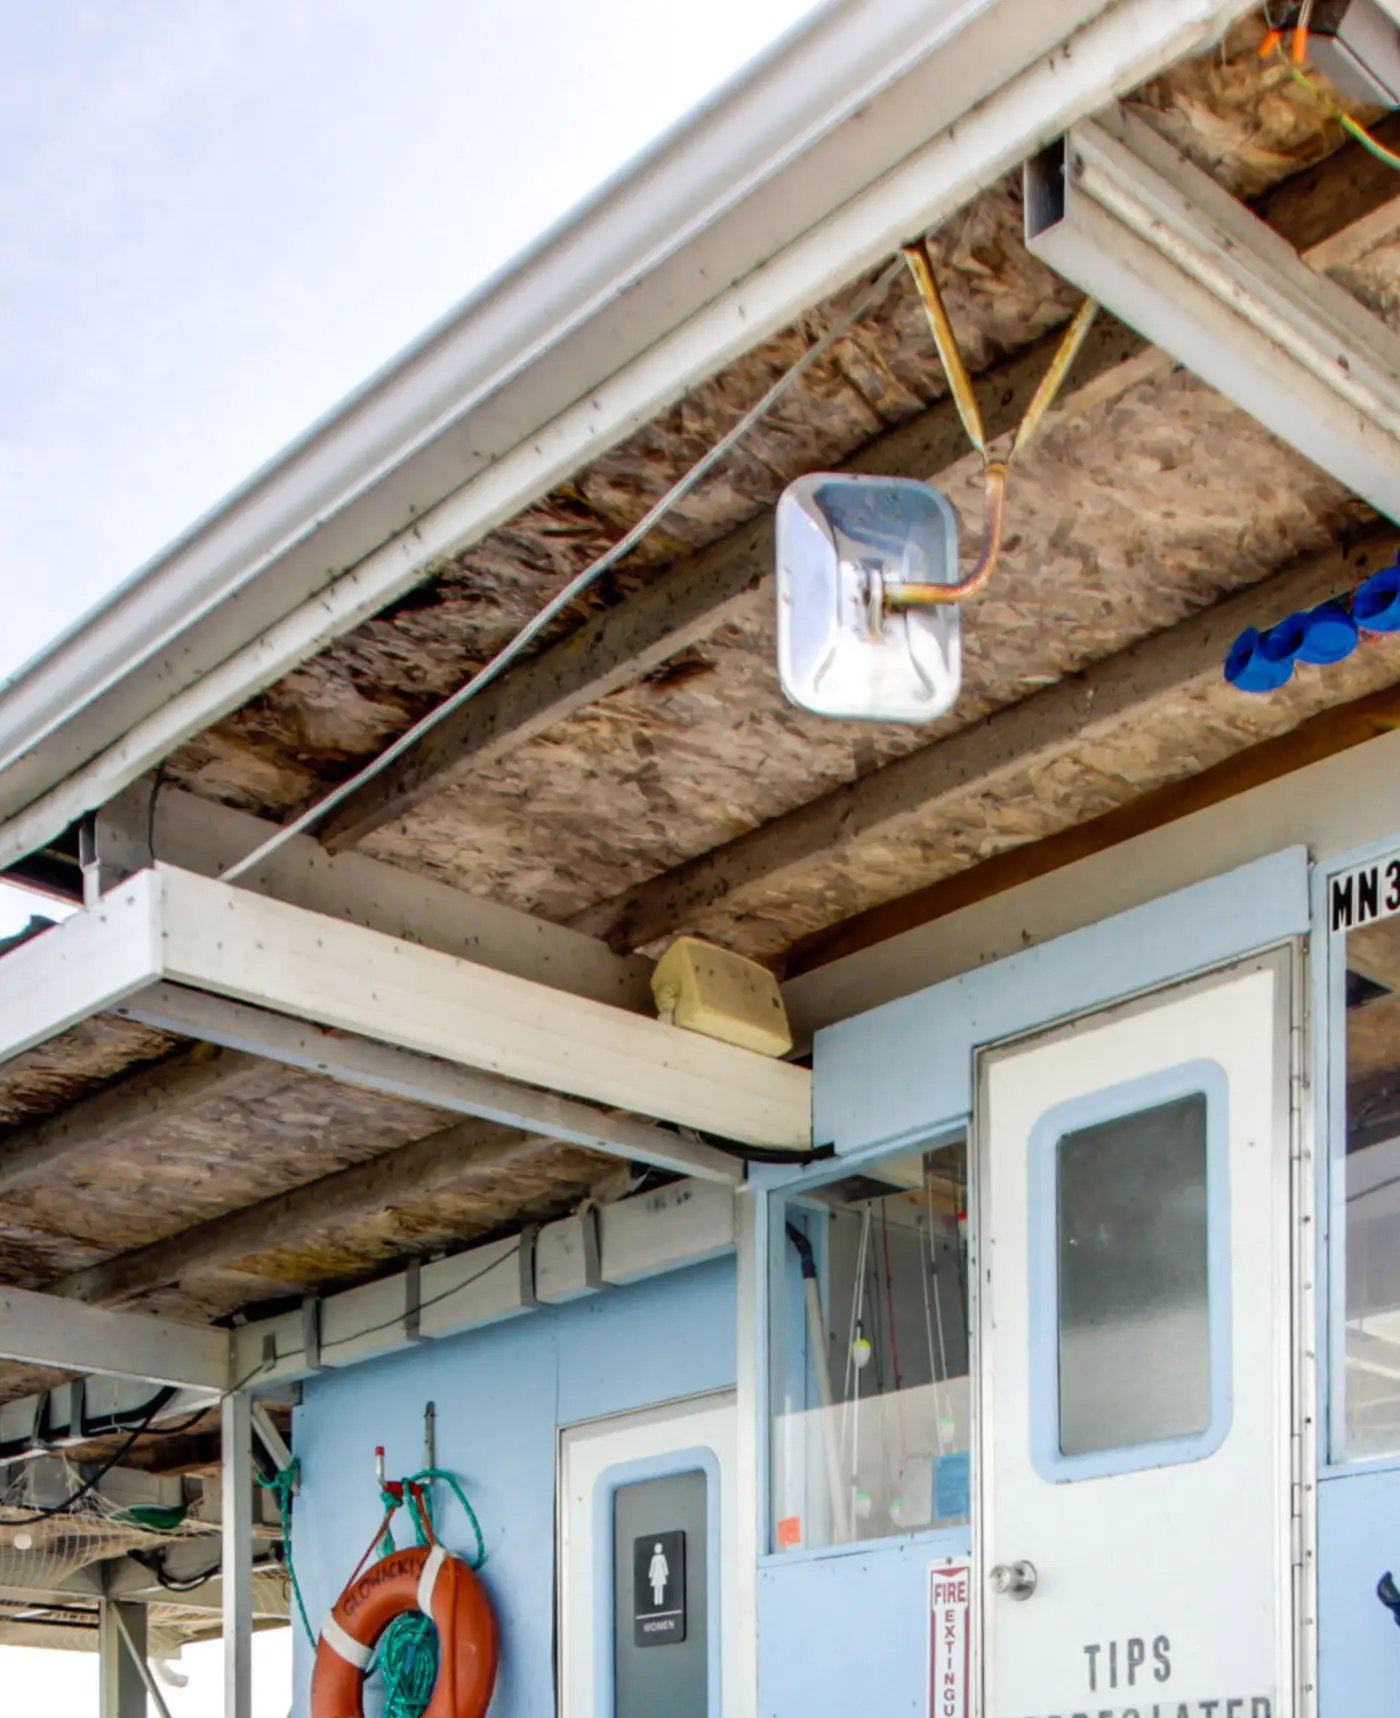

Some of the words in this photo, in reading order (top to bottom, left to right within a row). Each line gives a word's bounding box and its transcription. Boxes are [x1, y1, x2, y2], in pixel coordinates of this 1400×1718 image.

[934, 1580, 967, 1605] FIRE
[643, 1619, 675, 1633] WOMEN
[1084, 1635, 1171, 1691] TIPS
